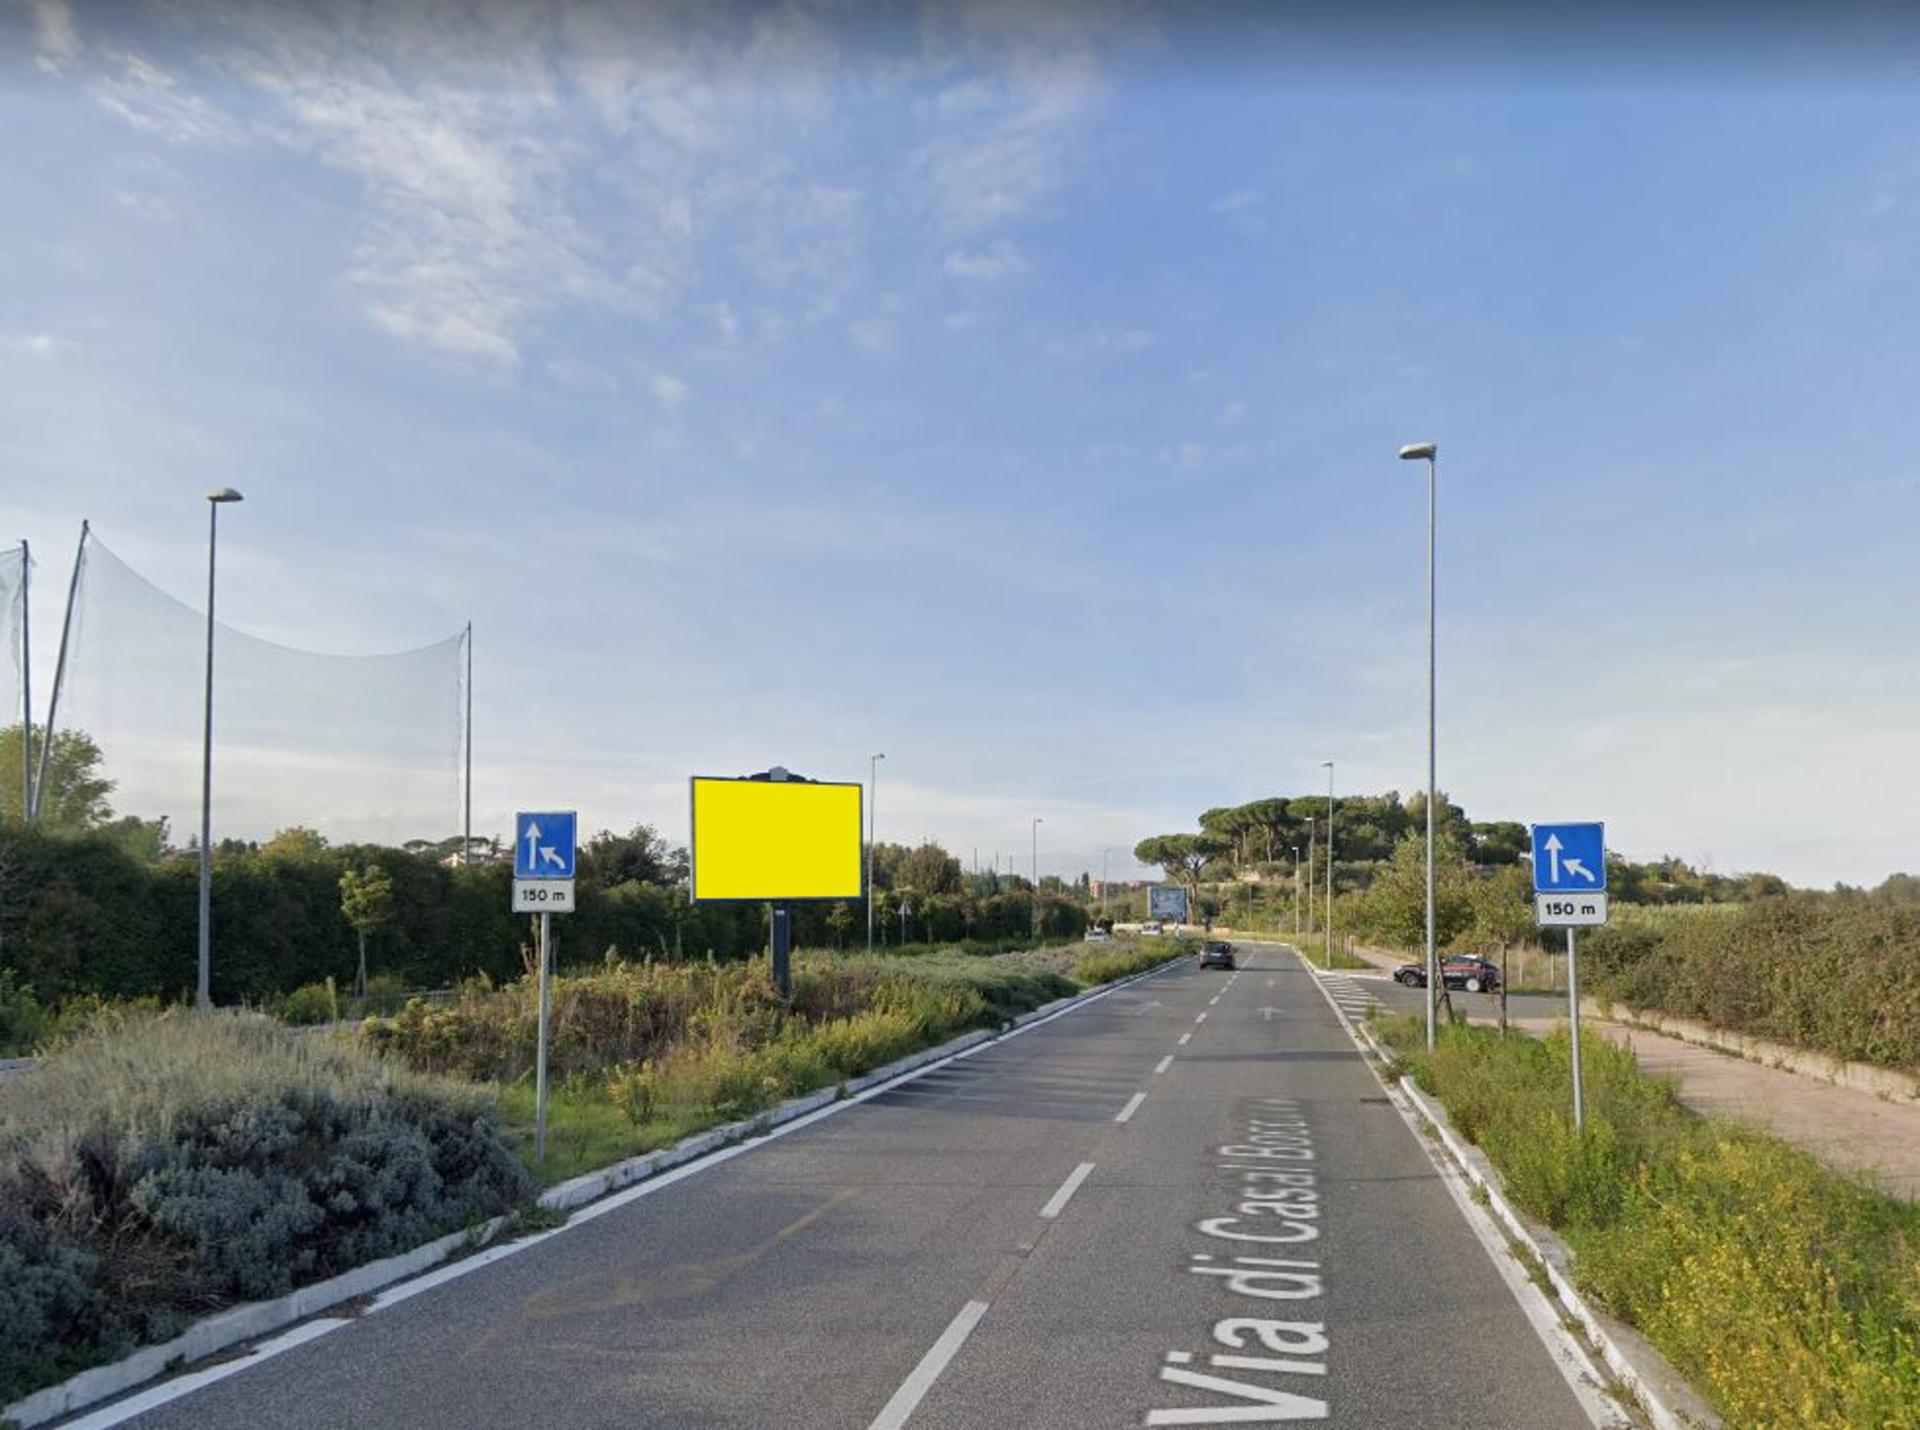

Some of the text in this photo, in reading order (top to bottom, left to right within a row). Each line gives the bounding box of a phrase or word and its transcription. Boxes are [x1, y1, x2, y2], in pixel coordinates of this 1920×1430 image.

[522, 889, 566, 901] 150 m
[1545, 902, 1596, 915] 150 m
